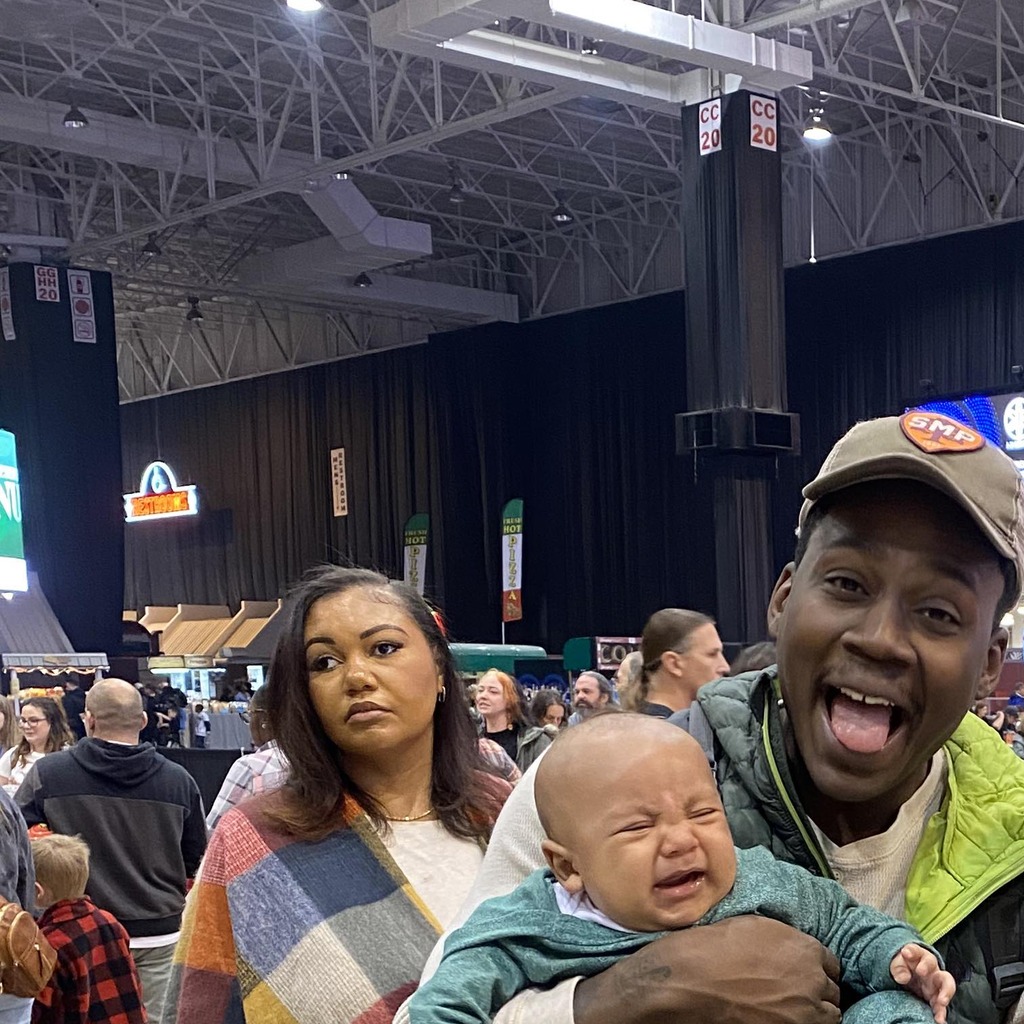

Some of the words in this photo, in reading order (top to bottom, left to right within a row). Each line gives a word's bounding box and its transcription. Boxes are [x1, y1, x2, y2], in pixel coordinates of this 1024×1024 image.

[701, 104, 719, 123] CC
[752, 100, 775, 119] CC
[701, 129, 720, 150] 20
[752, 124, 776, 146] 20
[37, 267, 56, 277] GG
[38, 277, 57, 287] HH
[39, 288, 58, 300] 20
[503, 524, 521, 533] HOT
[405, 536, 426, 545] HOT
[508, 535, 518, 601] PIZZA
